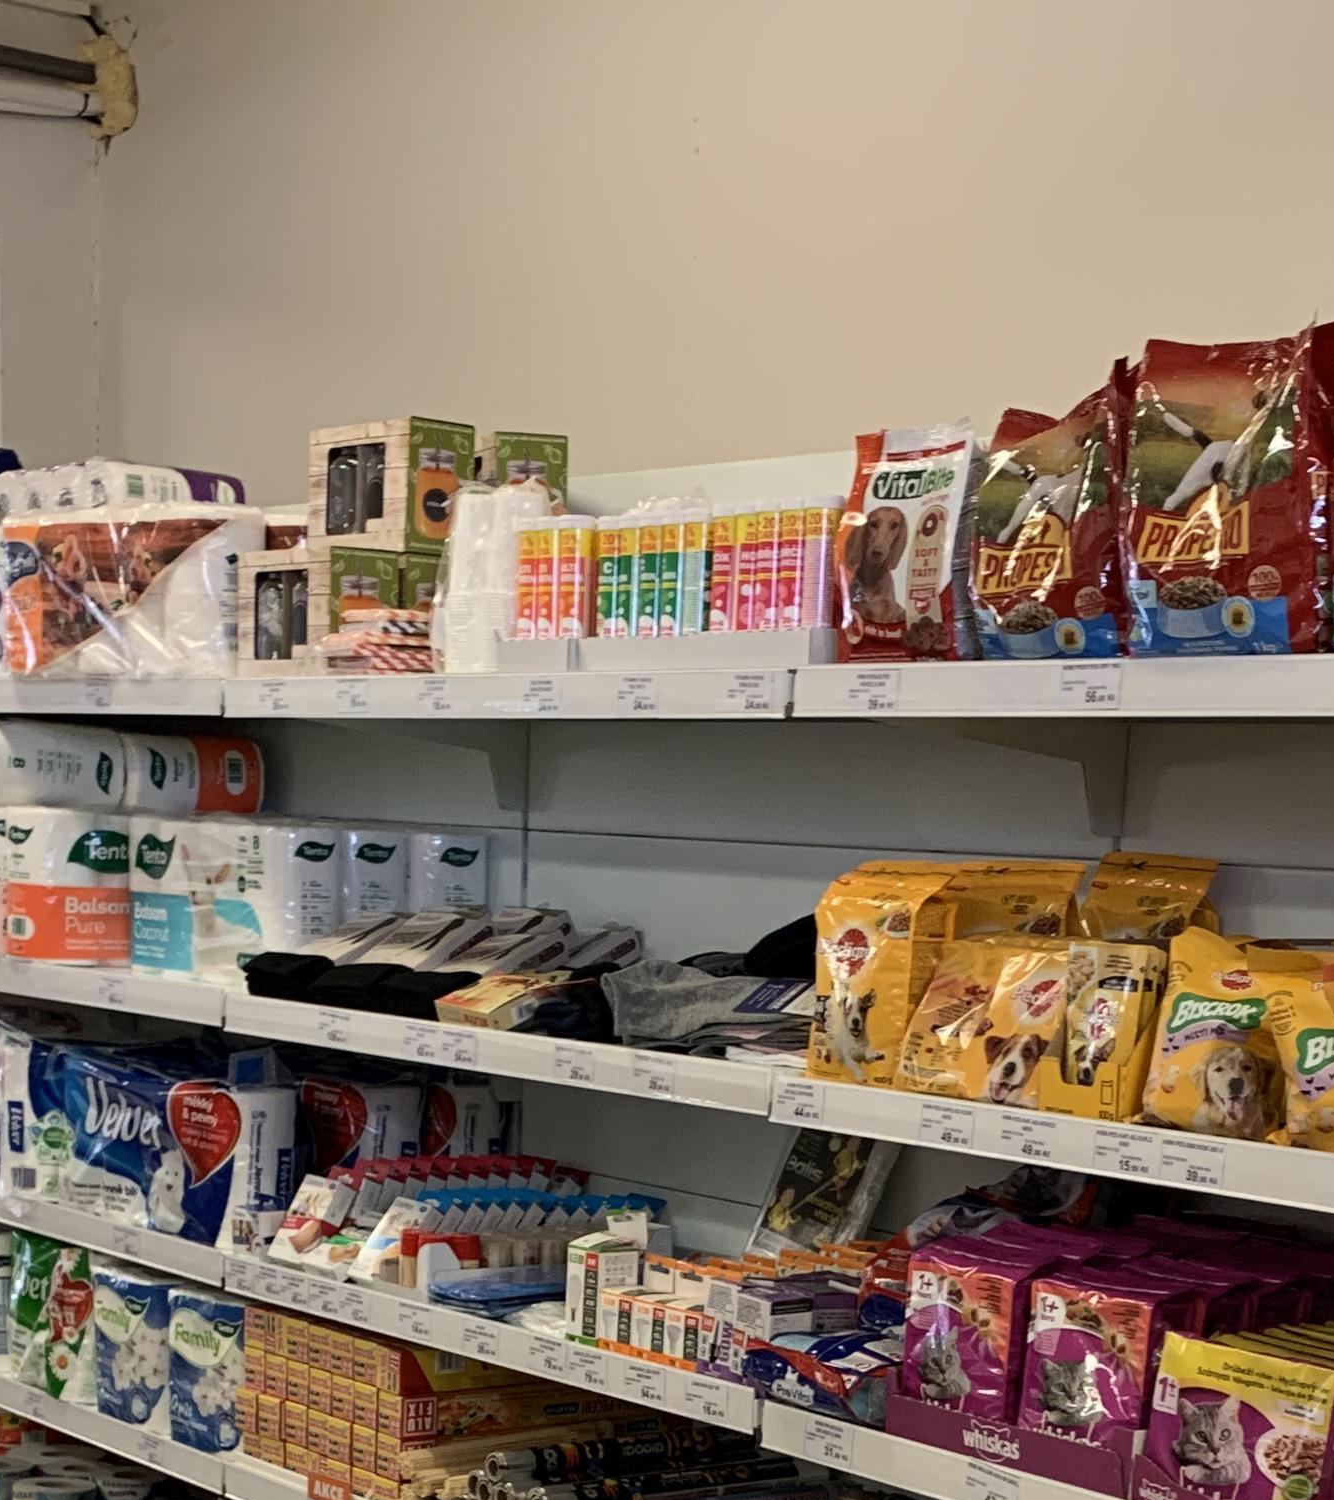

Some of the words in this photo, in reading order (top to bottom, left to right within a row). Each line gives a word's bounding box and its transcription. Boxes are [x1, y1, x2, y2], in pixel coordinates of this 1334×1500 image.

[64, 918, 106, 936] Pure
[1174, 999, 1259, 1026] BISCROK
[174, 1321, 221, 1352] Family
[962, 1428, 1020, 1460] whiskas
